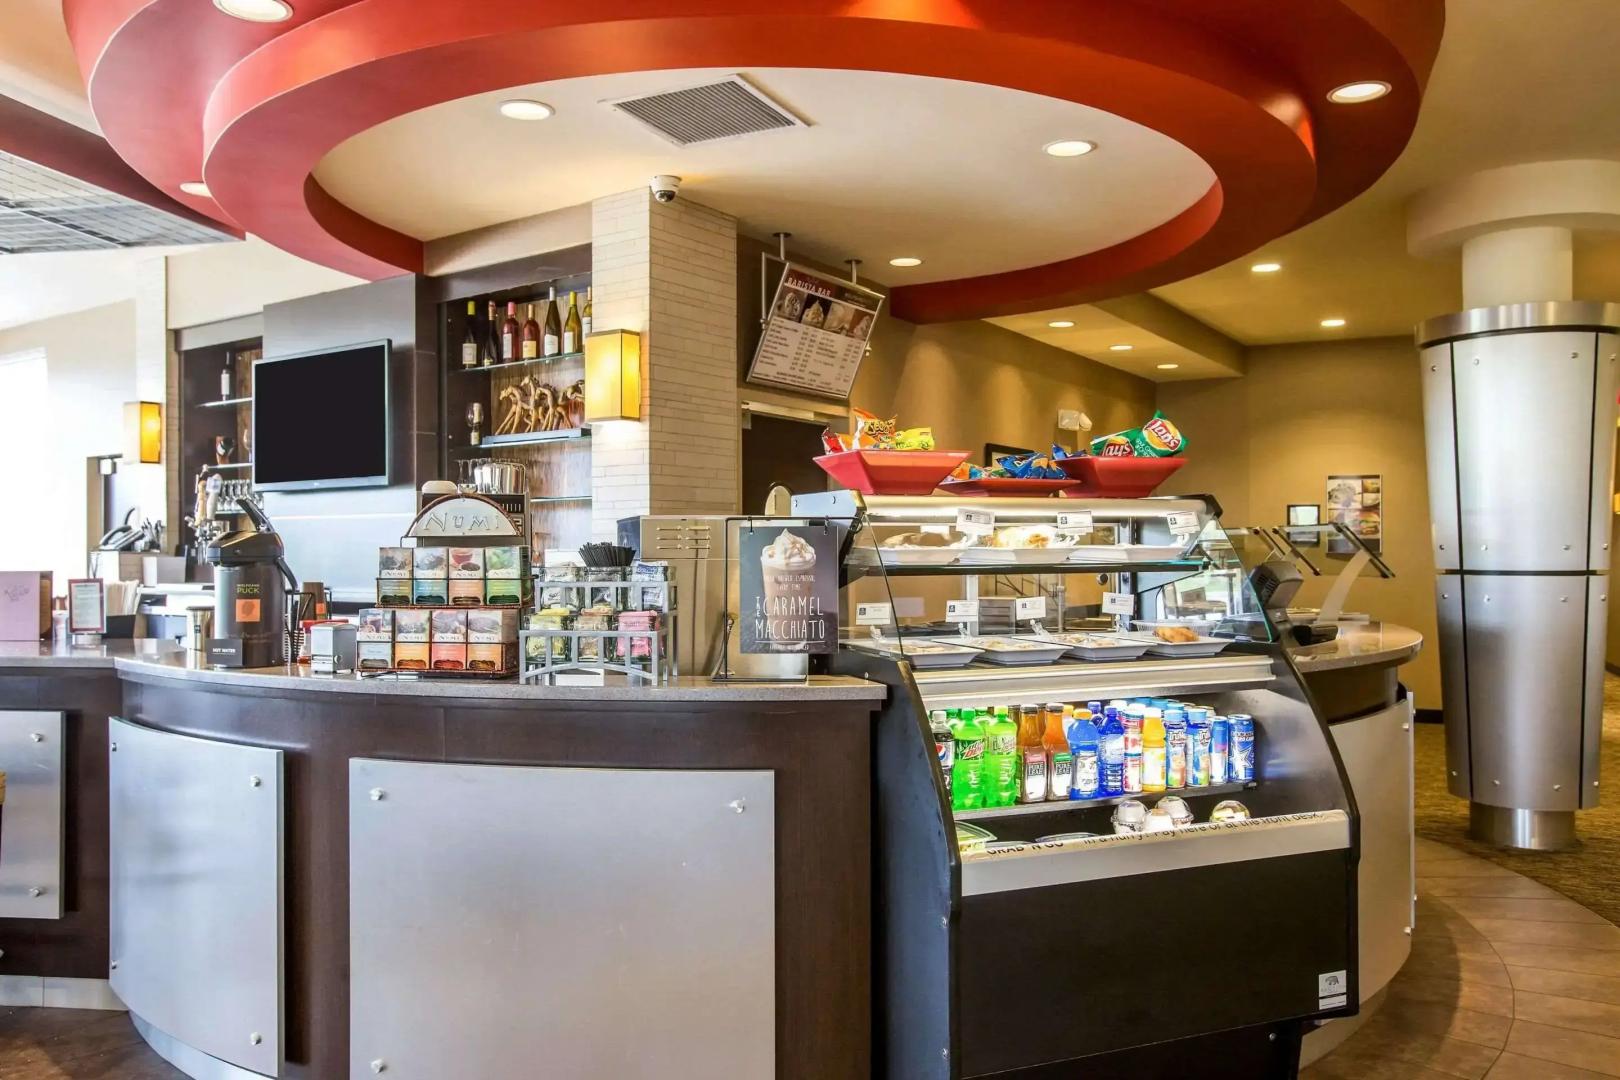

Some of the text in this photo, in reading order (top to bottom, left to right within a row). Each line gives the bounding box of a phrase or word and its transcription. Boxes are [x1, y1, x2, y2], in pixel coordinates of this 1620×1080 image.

[787, 277, 831, 297] BARISTA BAR
[763, 596, 824, 616] CARAMEL
[755, 619, 825, 639] MACCHIATO
